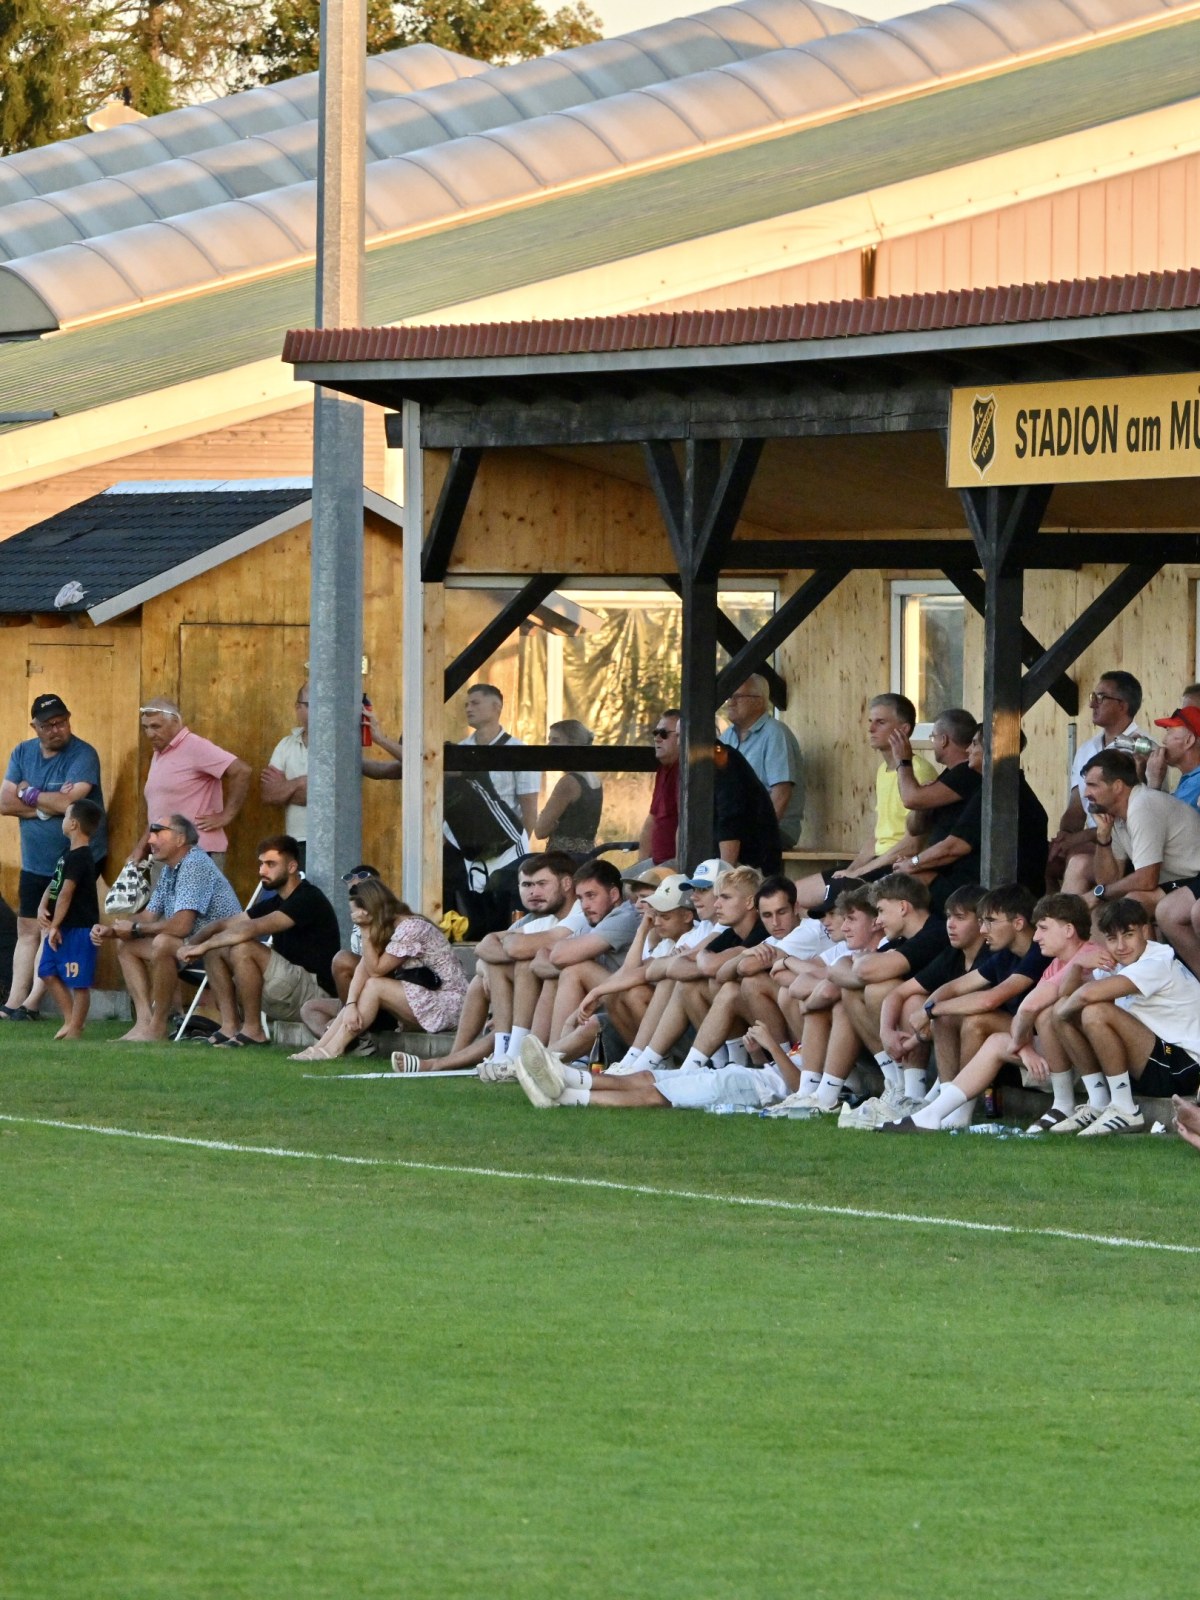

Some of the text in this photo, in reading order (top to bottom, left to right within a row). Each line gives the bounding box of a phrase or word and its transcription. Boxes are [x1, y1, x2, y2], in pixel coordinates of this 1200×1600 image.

[1015, 404, 1119, 459] STADION
[1126, 415, 1162, 453] am
[64, 962, 79, 978] 19
